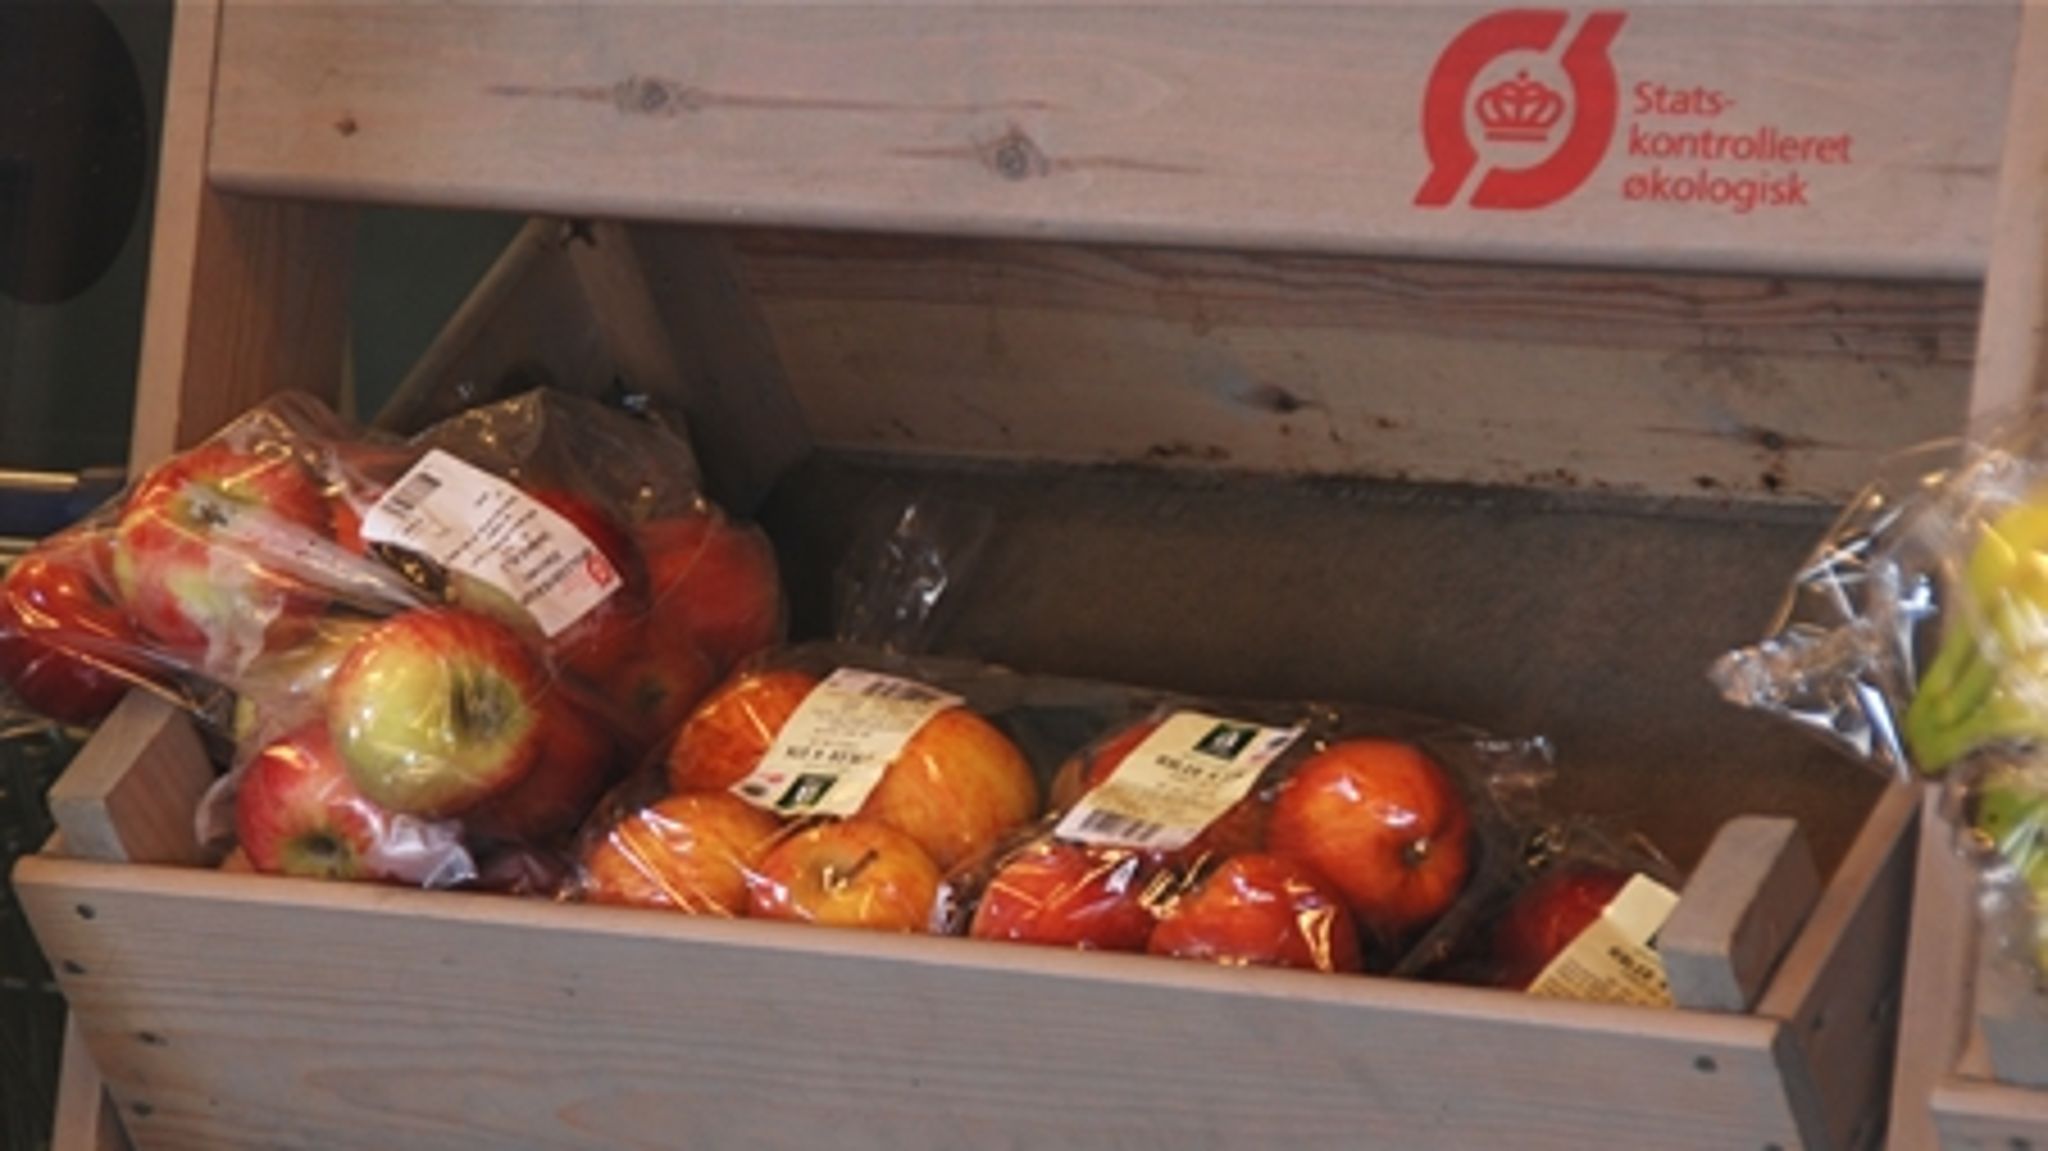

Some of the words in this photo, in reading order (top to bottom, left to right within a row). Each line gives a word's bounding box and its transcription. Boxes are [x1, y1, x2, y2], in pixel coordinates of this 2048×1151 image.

[1633, 81, 1735, 117] Stats-
[1628, 123, 1854, 164] kontrolleret
[1621, 167, 1809, 215] økologisk
